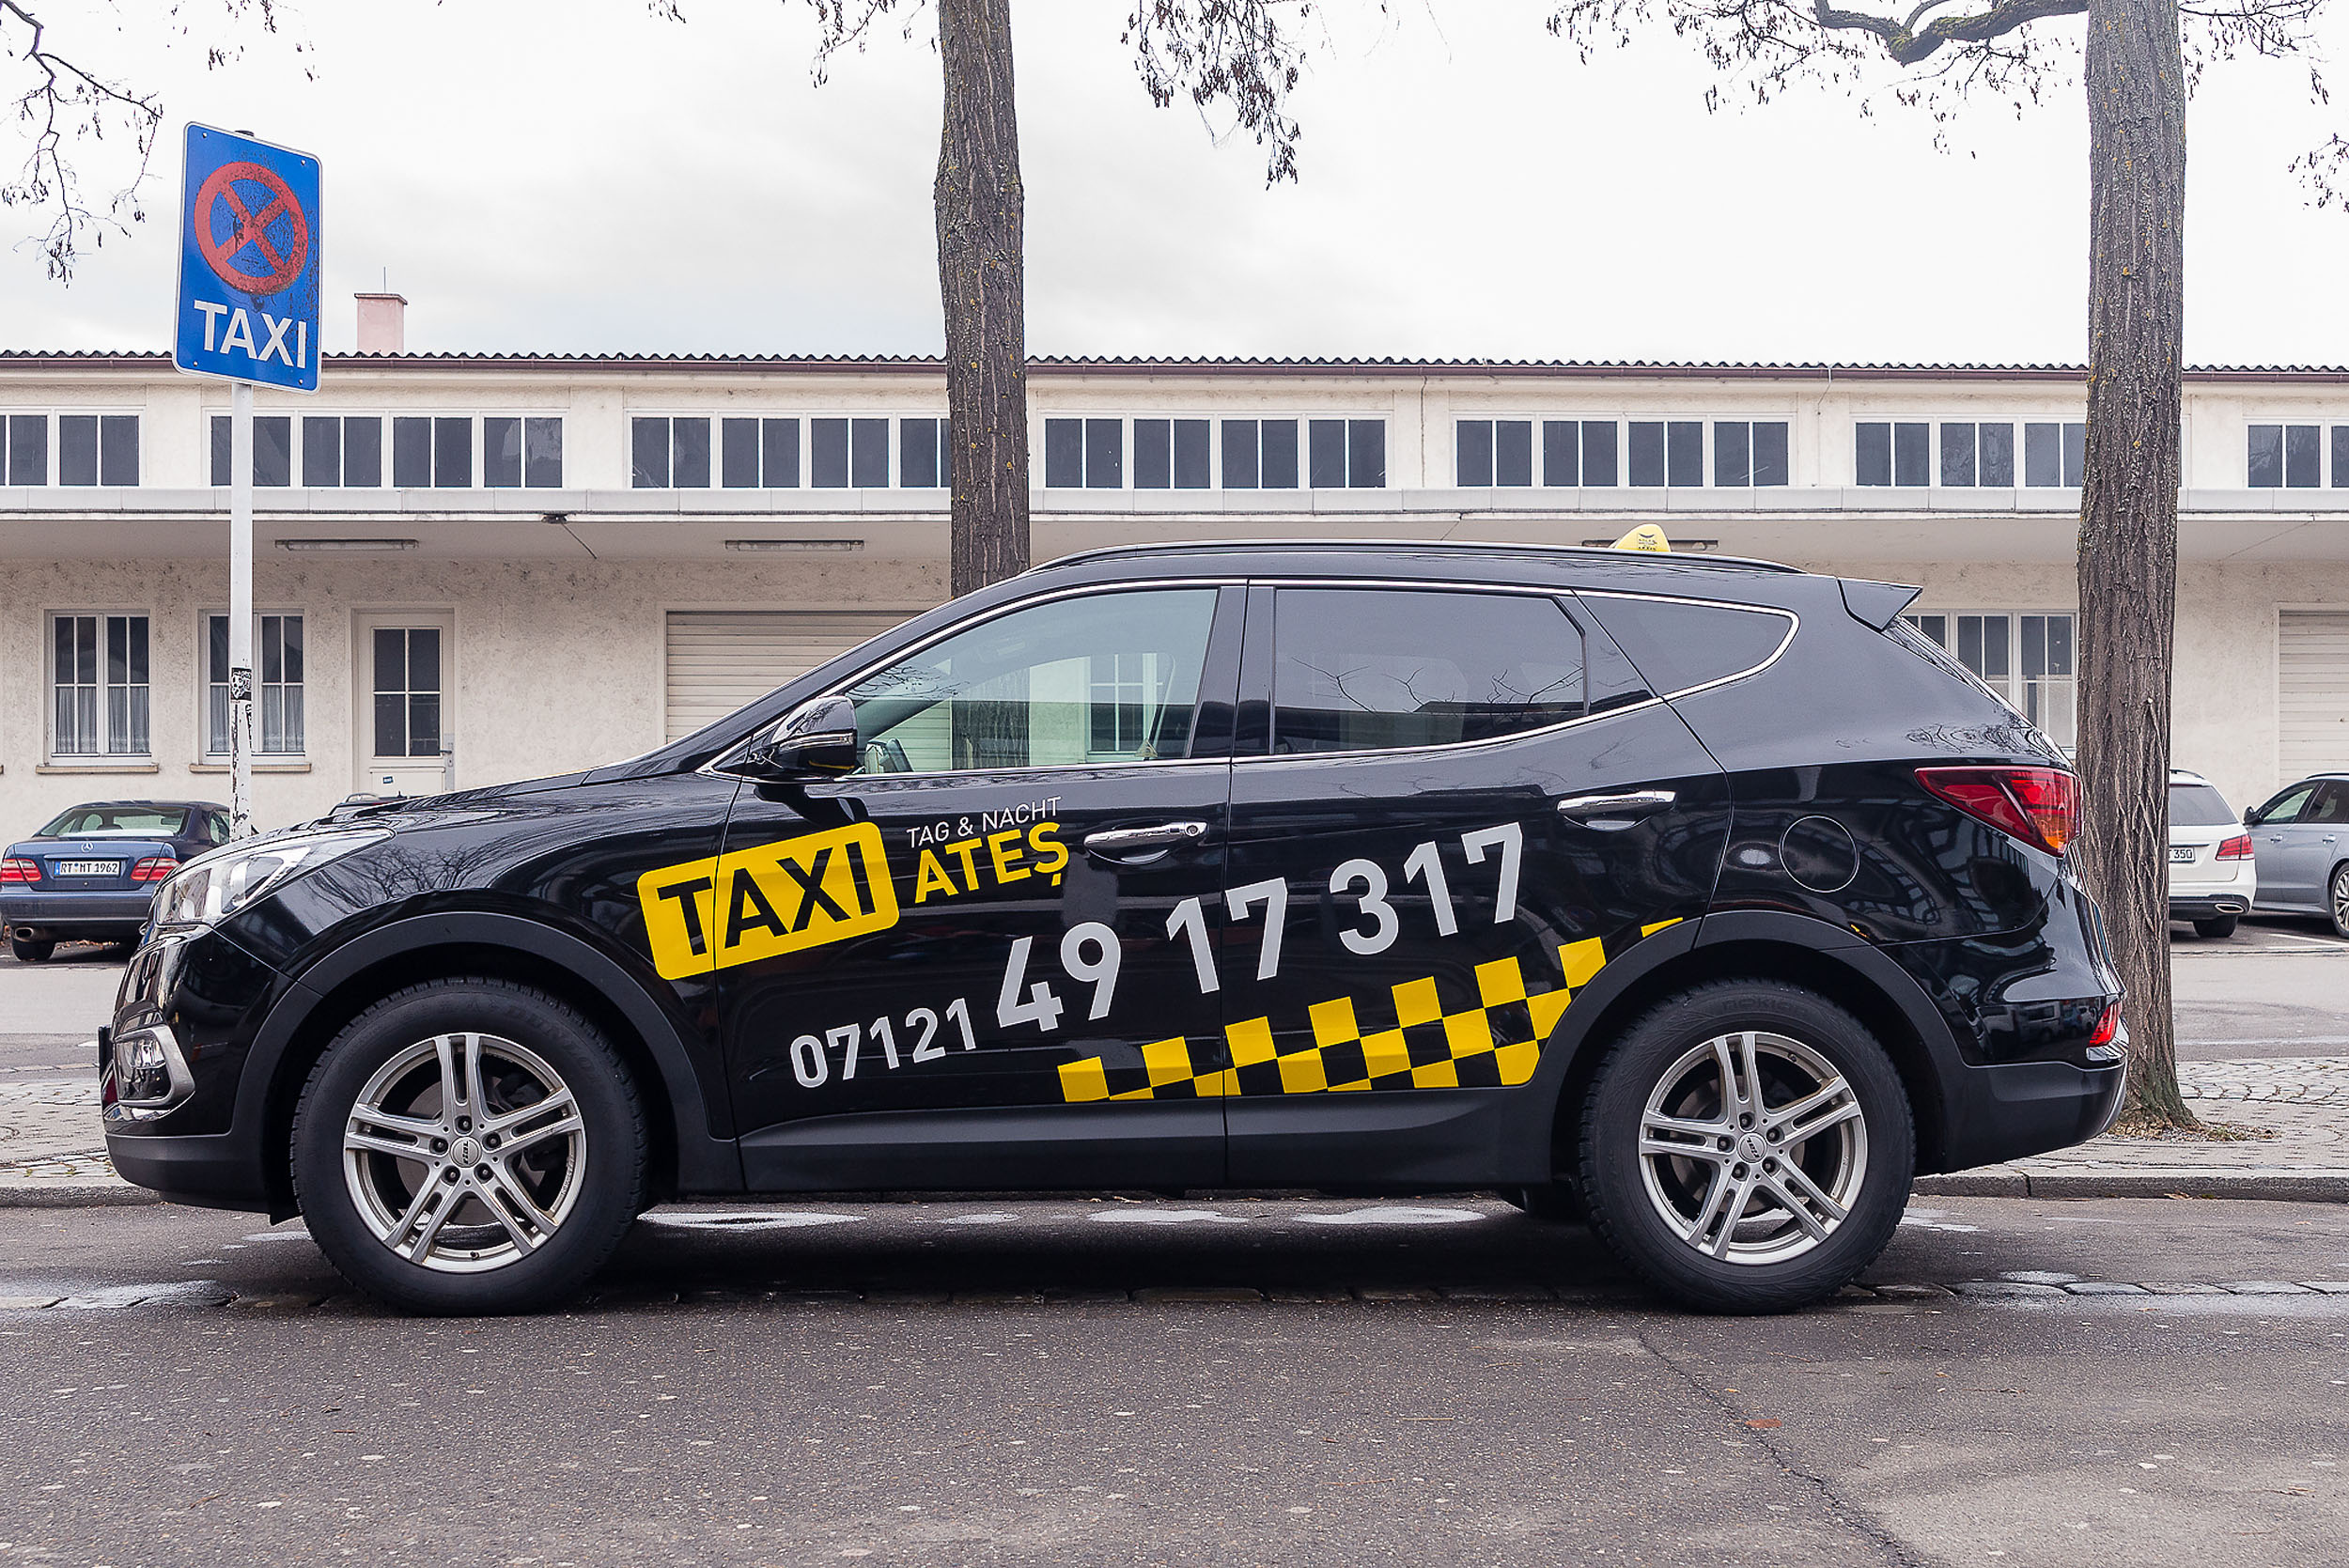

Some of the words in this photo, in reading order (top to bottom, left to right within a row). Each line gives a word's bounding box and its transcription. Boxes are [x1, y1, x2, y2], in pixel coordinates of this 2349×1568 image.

[194, 299, 308, 369] TAXI
[906, 821, 950, 848] TAG
[957, 816, 974, 837] &
[982, 796, 1062, 832] NACHT
[60, 862, 73, 873] RT
[94, 862, 118, 873] 1962
[2173, 848, 2193, 859] 350
[657, 840, 878, 956] TAXI
[788, 998, 978, 1089] 07121
[996, 921, 1123, 1032] 49
[1166, 877, 1288, 994] 17
[1329, 821, 1523, 955] 317
